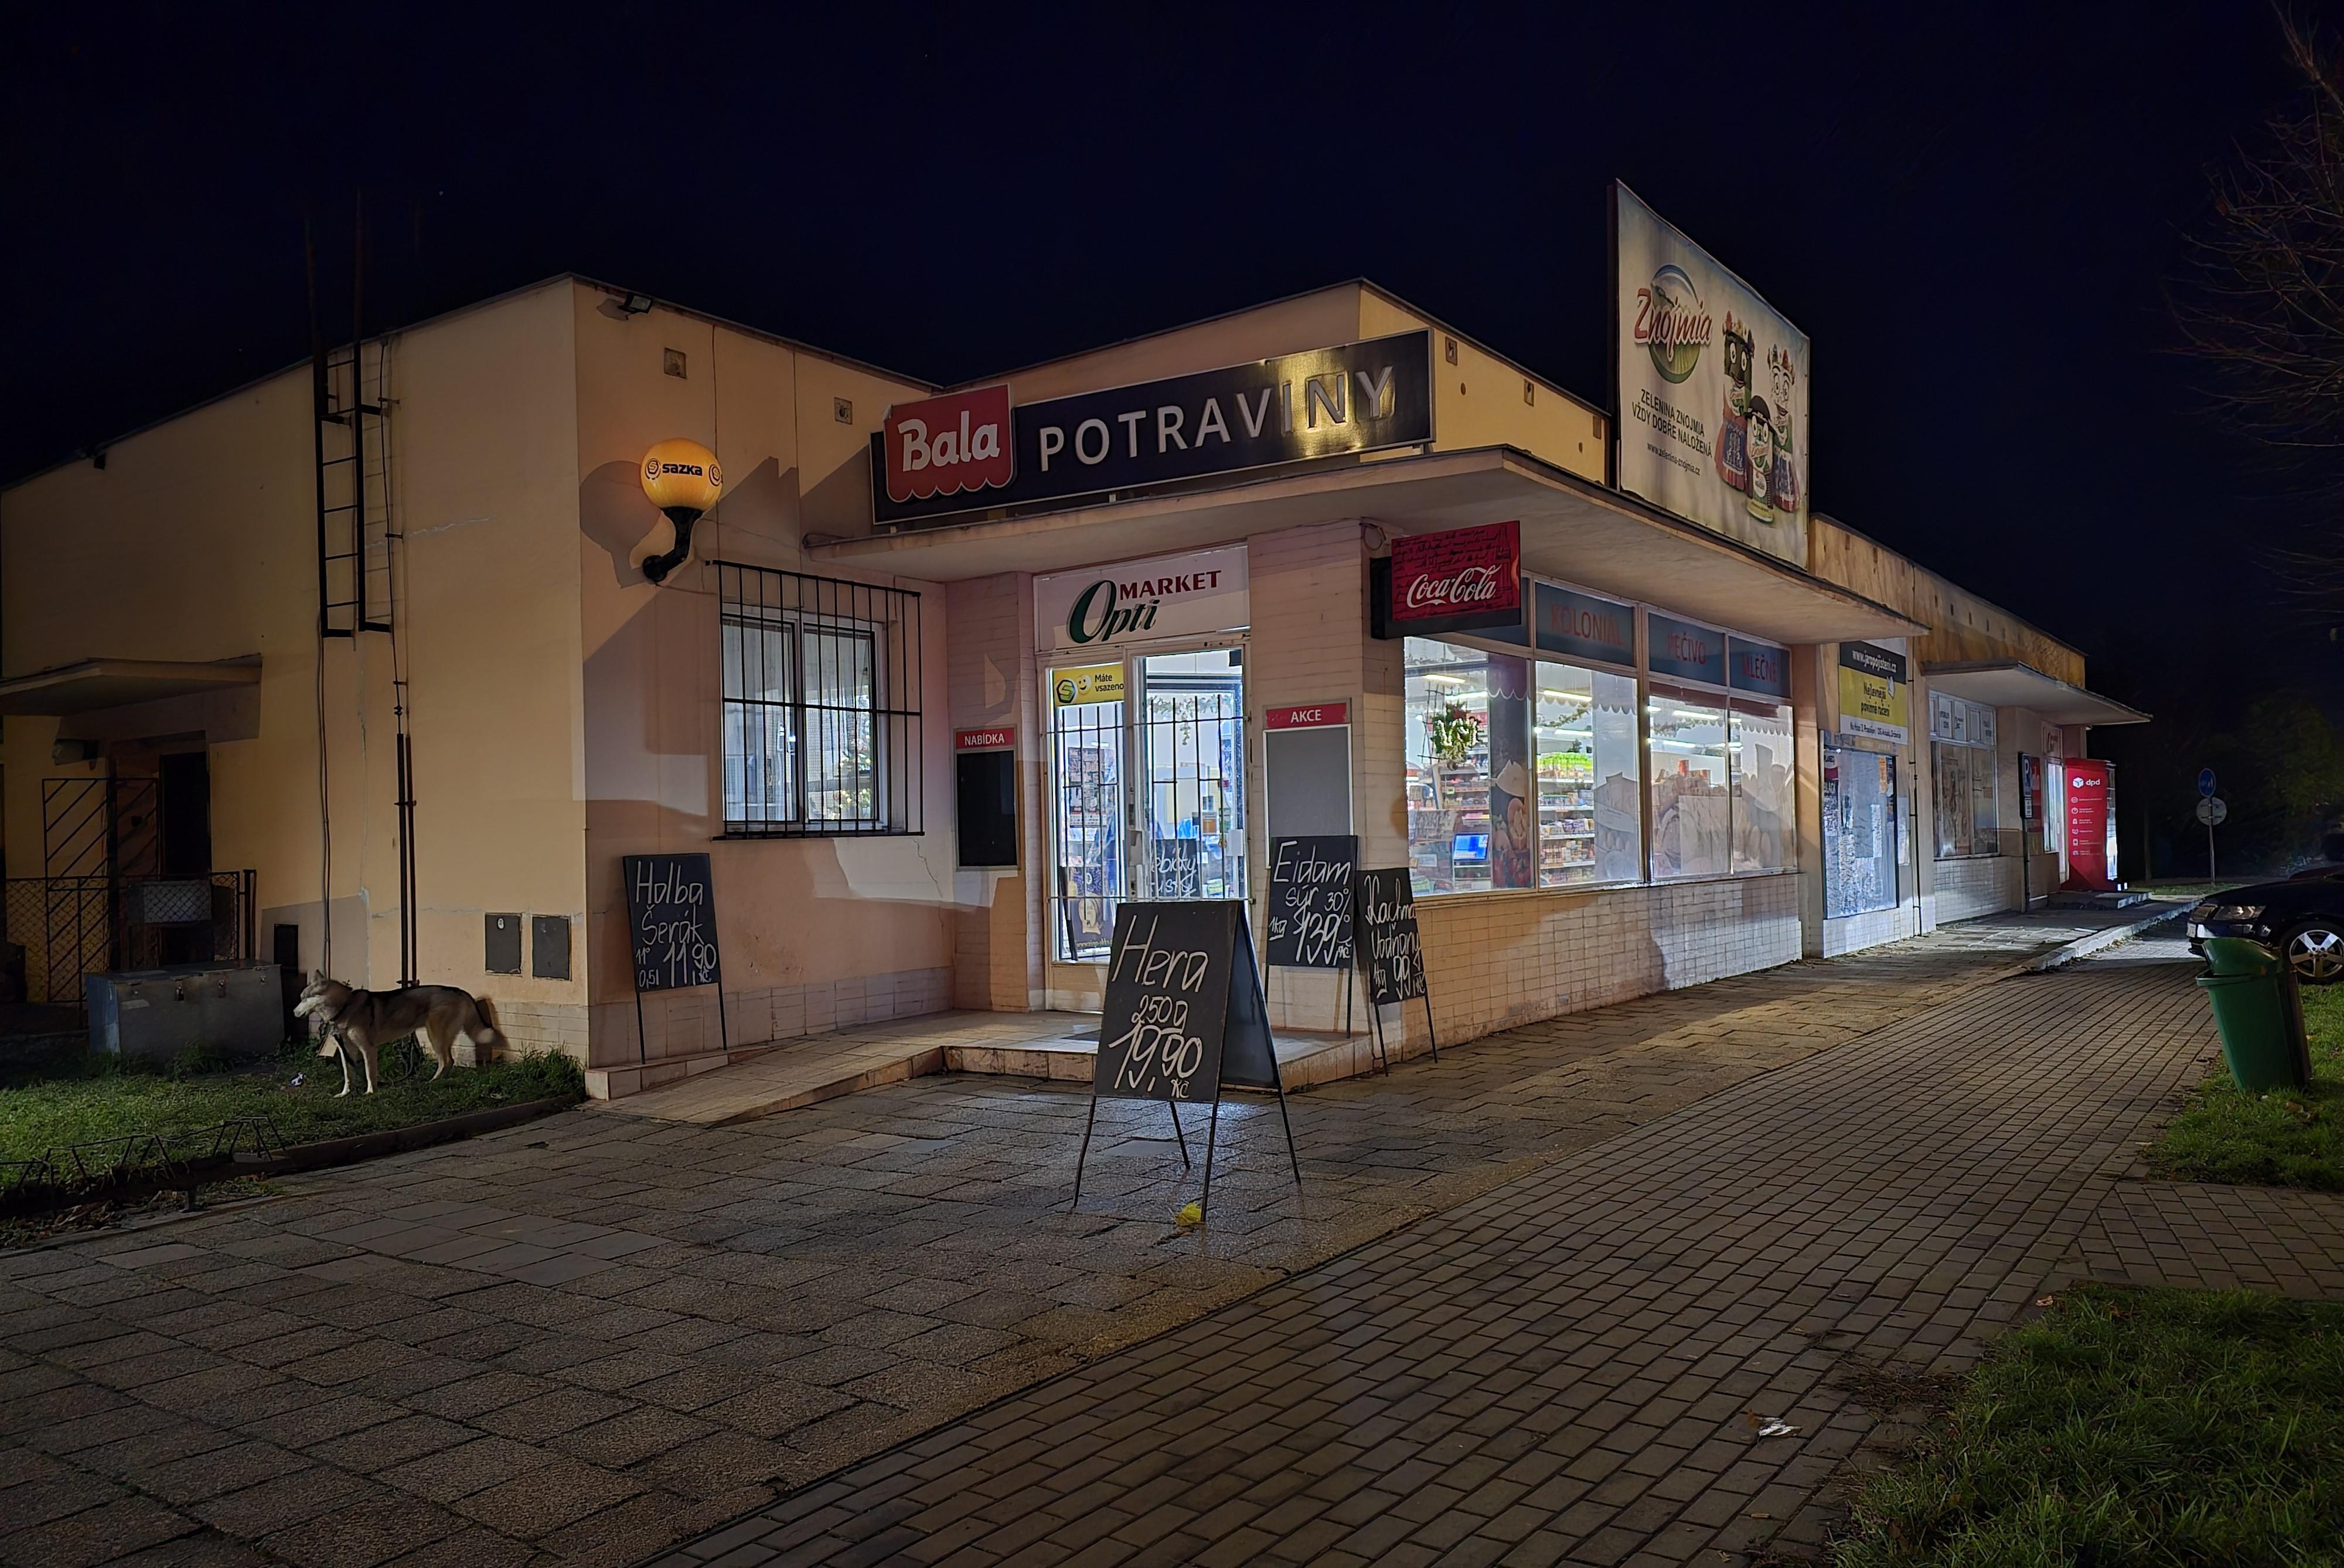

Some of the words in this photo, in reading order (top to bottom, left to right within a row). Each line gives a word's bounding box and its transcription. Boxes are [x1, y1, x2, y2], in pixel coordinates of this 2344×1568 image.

[1634, 288, 1713, 360] Znojmia
[1040, 366, 1394, 472] POTRAVINY
[1632, 401, 1651, 425] VŽDY
[1652, 414, 1677, 439] DOBŘE
[1678, 428, 1712, 458] NALOŽENÁ
[1641, 388, 1675, 421] ZELENINA
[1676, 410, 1705, 437] ZNOJMIA
[897, 410, 1000, 472] Bala
[662, 463, 703, 476] sazka
[1119, 570, 1222, 601] MARKET
[1406, 564, 1502, 608] Coca-Cola
[1067, 580, 1160, 644] Opti
[1095, 674, 1113, 683] Máte
[1095, 683, 1125, 692] vsazeno
[1290, 709, 1322, 723] AKCE
[965, 732, 1005, 746] NABÍDKA
[2086, 779, 2100, 787] dpd
[635, 860, 704, 905] Holba
[1273, 840, 1351, 885] Eidam
[641, 904, 704, 946] Šerák
[1285, 884, 1319, 934] sýr
[1324, 887, 1351, 923] 30%
[1111, 915, 1209, 993] Hera
[1170, 1078, 1190, 1099] Kč
